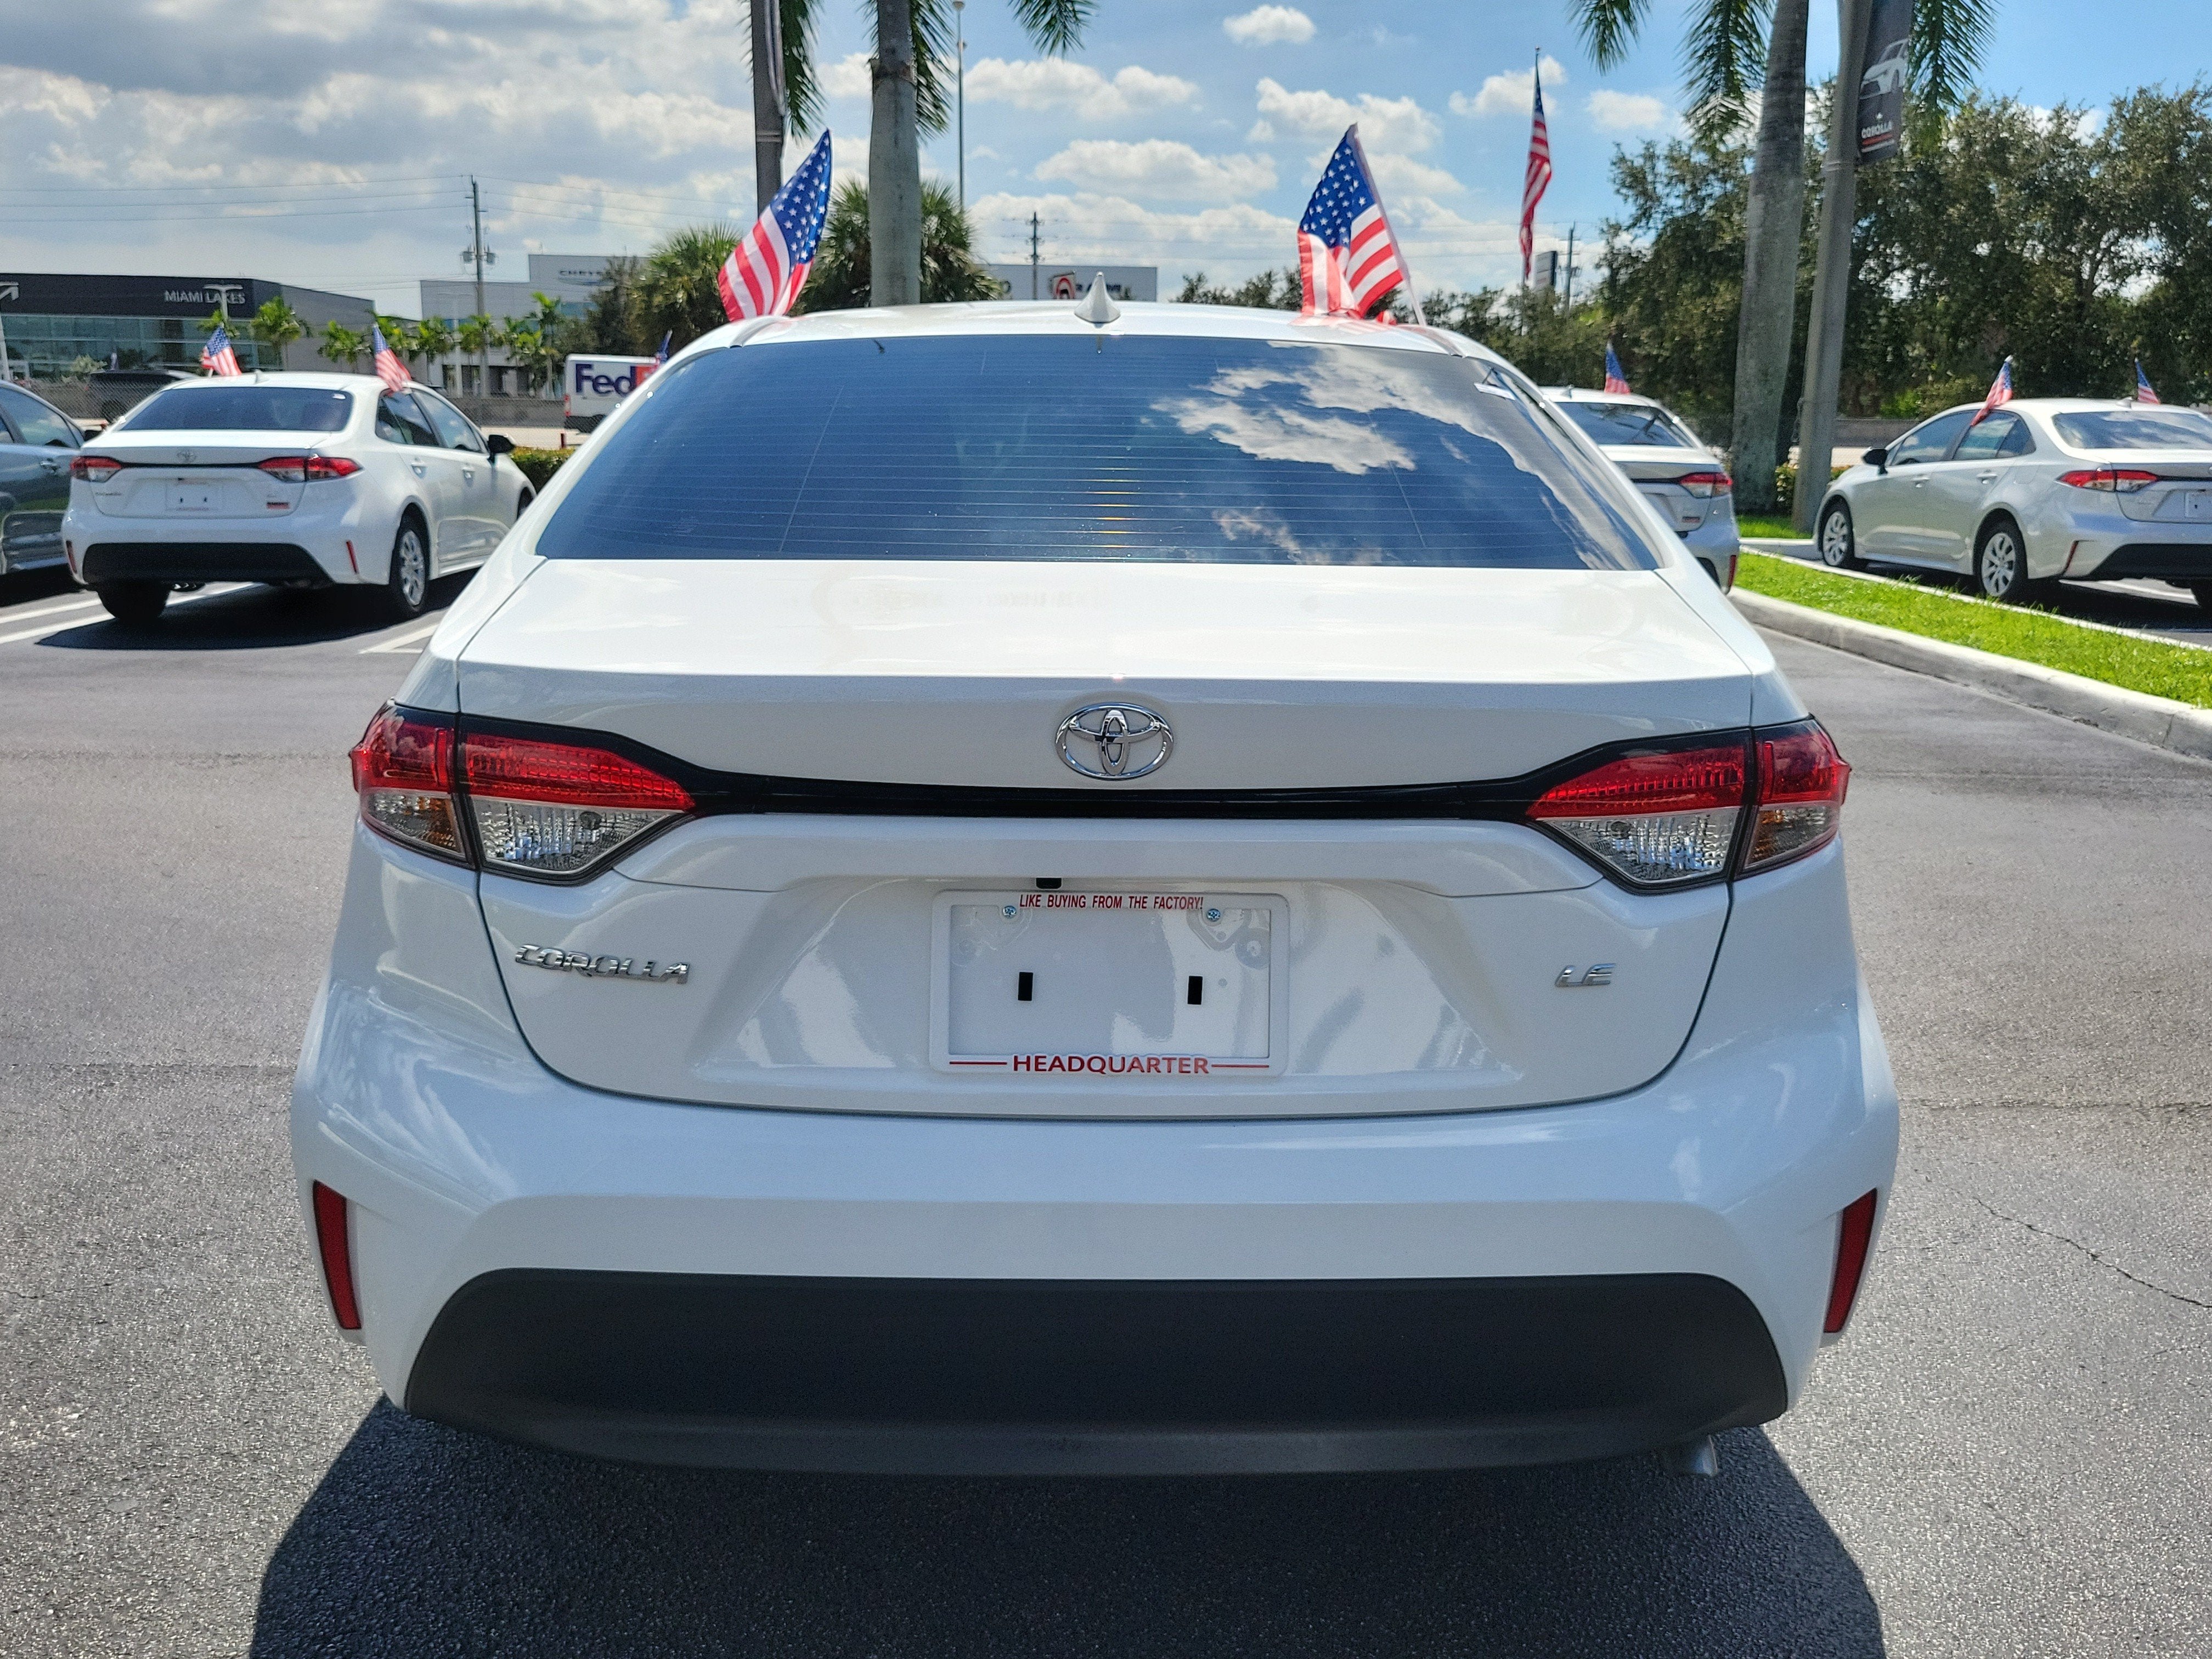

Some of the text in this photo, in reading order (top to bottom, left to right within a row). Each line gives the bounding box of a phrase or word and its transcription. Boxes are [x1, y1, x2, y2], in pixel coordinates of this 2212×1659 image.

[165, 290, 203, 302] MIAMI
[1019, 894, 1204, 910] LIKE BUYING FROM THE FACTORY!
[515, 944, 690, 984] COROLLA
[1554, 963, 1616, 988] LE
[1013, 1055, 1209, 1075] HEADQUARTER
